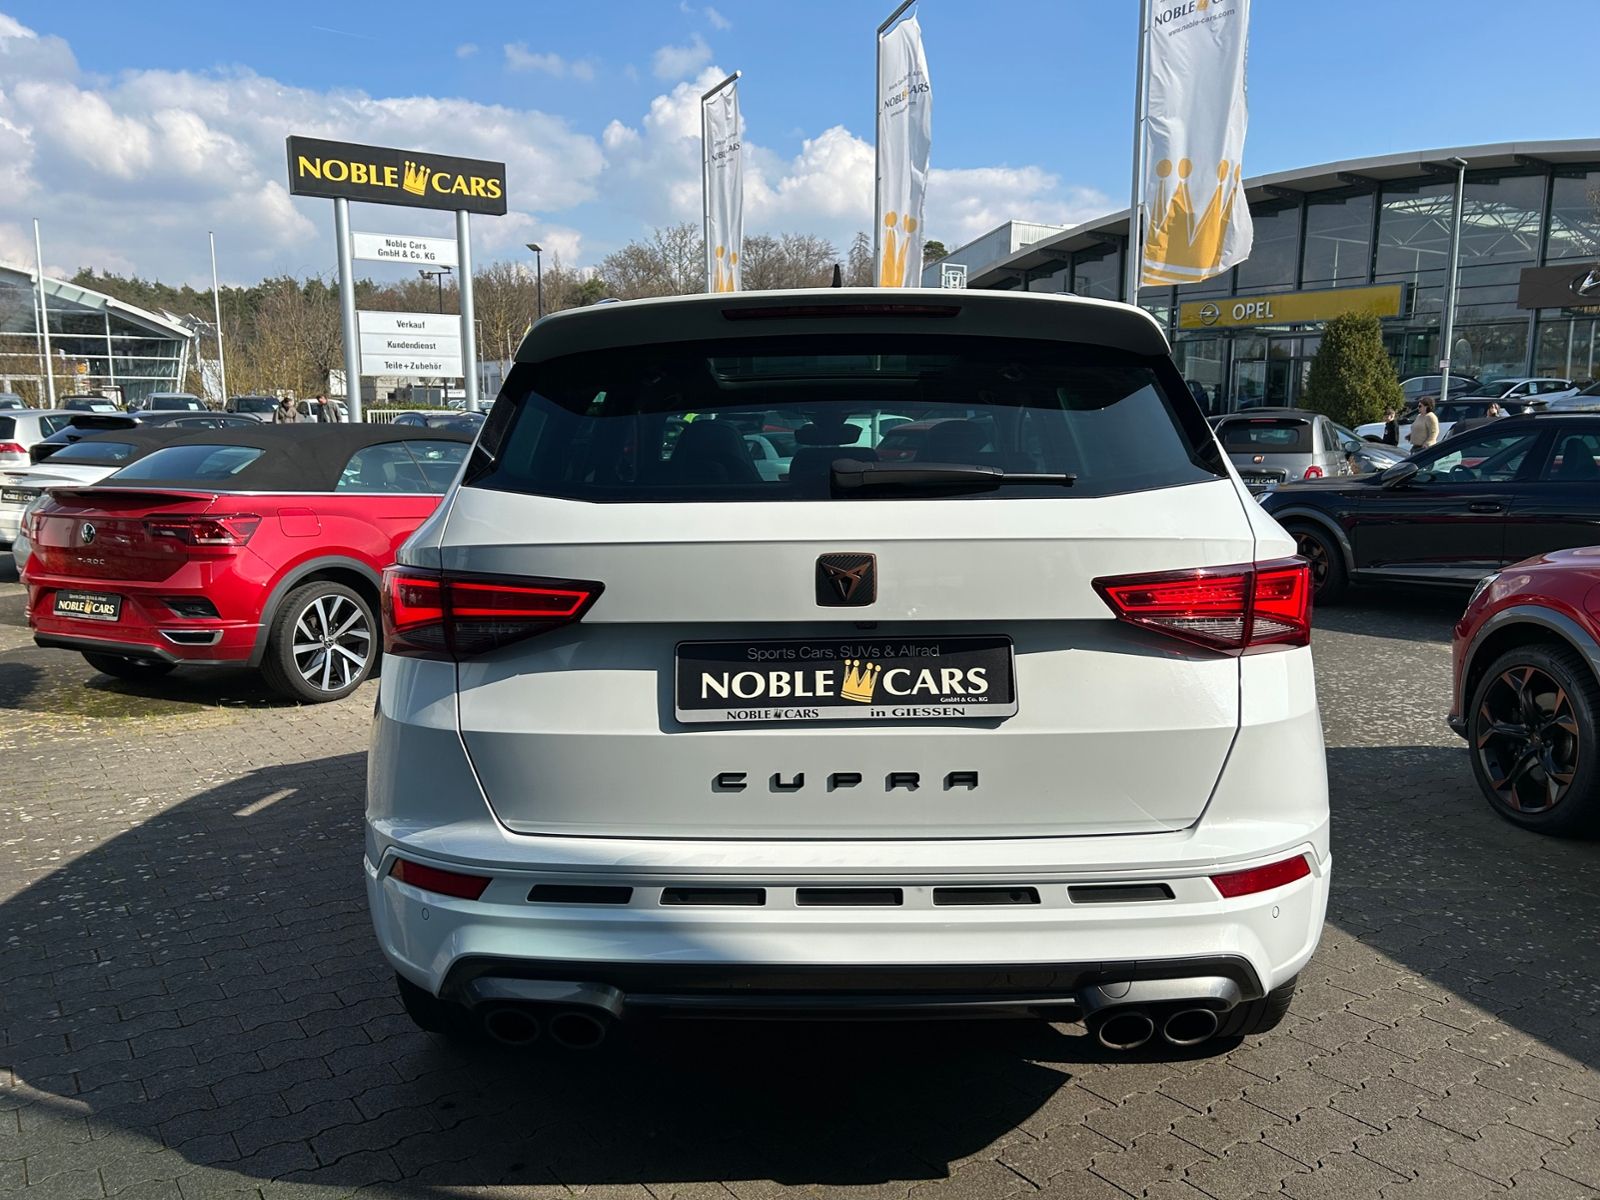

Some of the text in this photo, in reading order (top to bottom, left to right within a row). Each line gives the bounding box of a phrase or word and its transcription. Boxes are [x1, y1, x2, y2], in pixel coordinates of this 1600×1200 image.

[1154, 0, 1195, 27] NOBLE
[298, 156, 502, 199] NOBLE CARS
[385, 239, 427, 250] Noble Cars
[378, 248, 436, 260] GmbH & Co. KG
[1232, 301, 1274, 321] OPEL
[396, 320, 426, 329] Verkauf
[387, 340, 437, 350] Kundendienst
[58, 600, 115, 614] NOBLE CARS
[747, 644, 940, 661] Sports Cars, SUVs & Allrad
[701, 667, 989, 699] NOBLE CARS
[727, 709, 819, 720] NOBLE CARS
[870, 707, 965, 717] in GIESSEN
[711, 771, 979, 793] CUPRA
